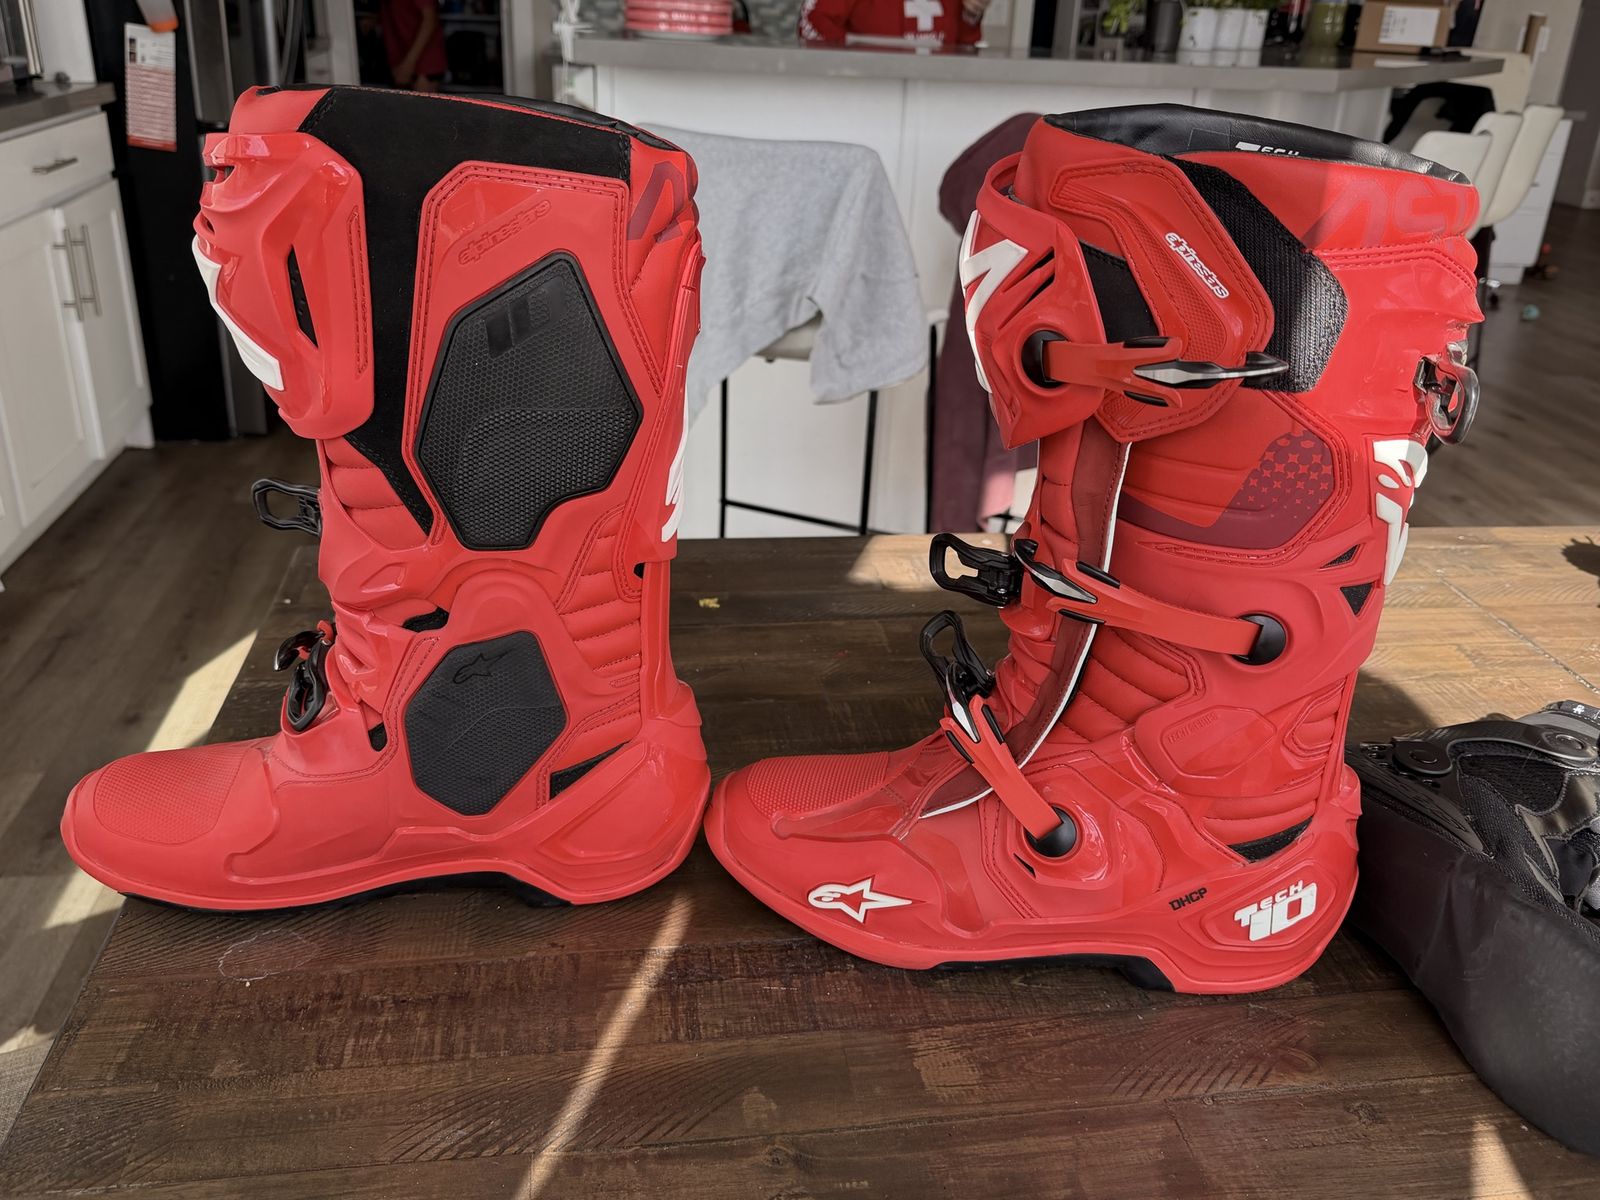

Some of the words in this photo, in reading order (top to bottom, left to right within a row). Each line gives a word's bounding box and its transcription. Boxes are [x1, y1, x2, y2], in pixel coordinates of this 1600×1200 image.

[1165, 232, 1229, 298] alpinestars
[1169, 887, 1208, 911] DHCP
[1234, 880, 1304, 928] TECH
[1249, 882, 1318, 942] 10
